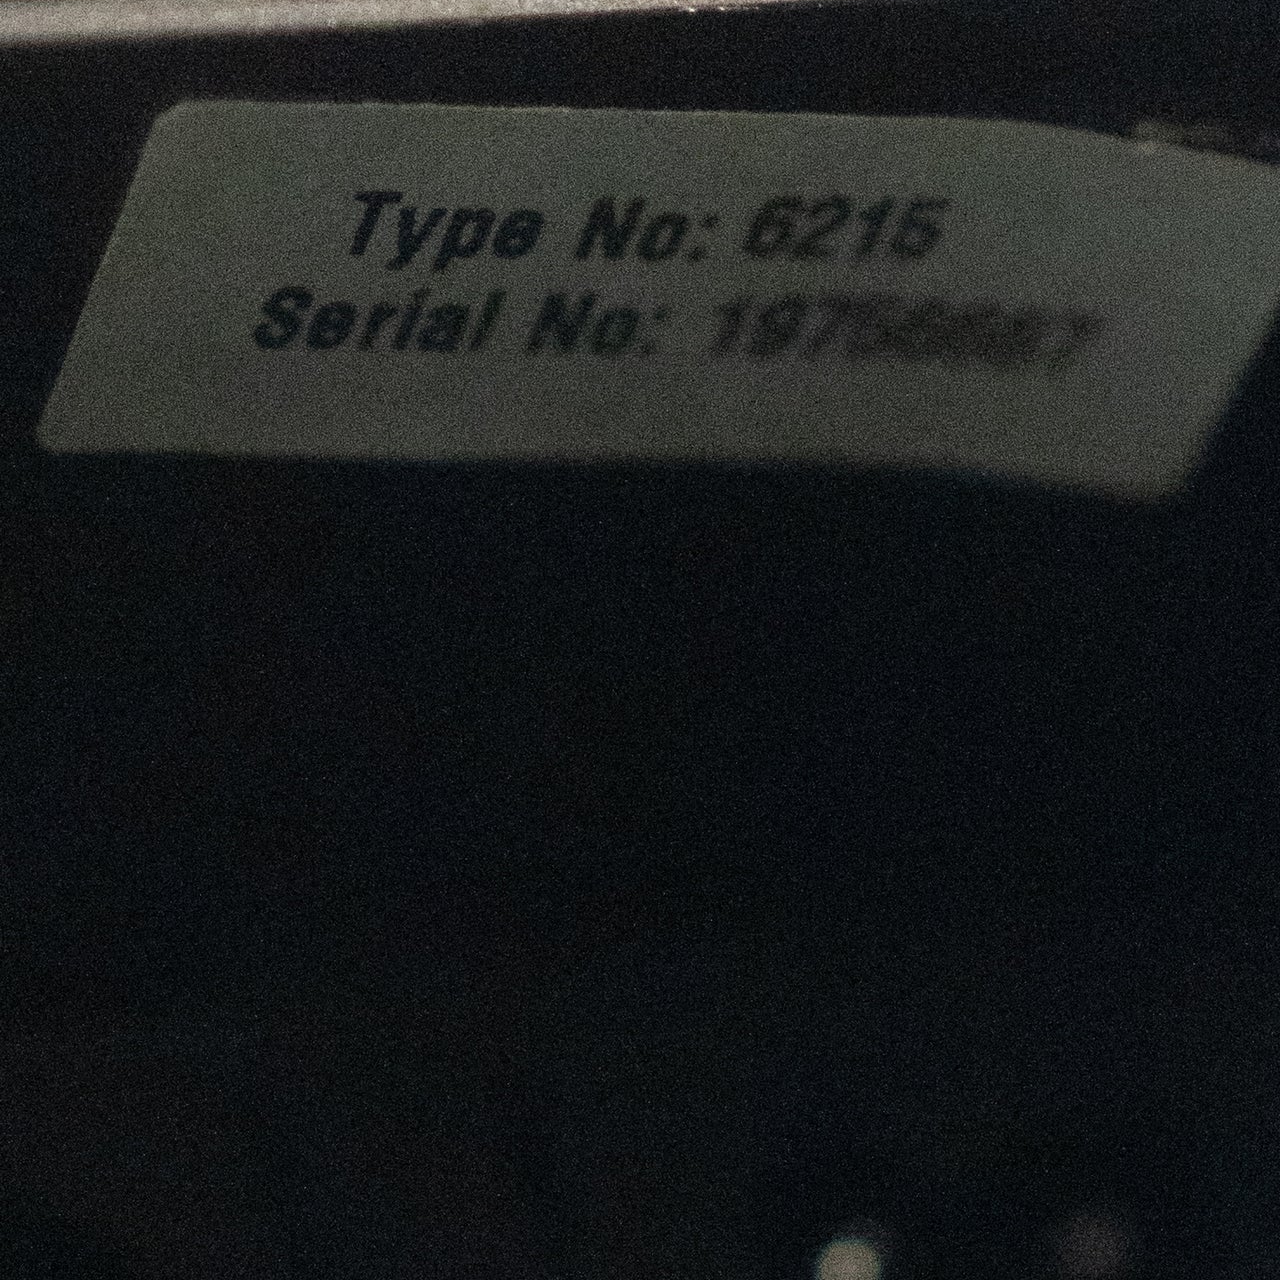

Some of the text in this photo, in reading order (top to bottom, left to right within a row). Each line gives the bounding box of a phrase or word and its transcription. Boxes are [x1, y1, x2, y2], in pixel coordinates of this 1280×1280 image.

[348, 188, 951, 275] Type No: 6215
[250, 284, 508, 356] Serial
[523, 290, 671, 360] No:
